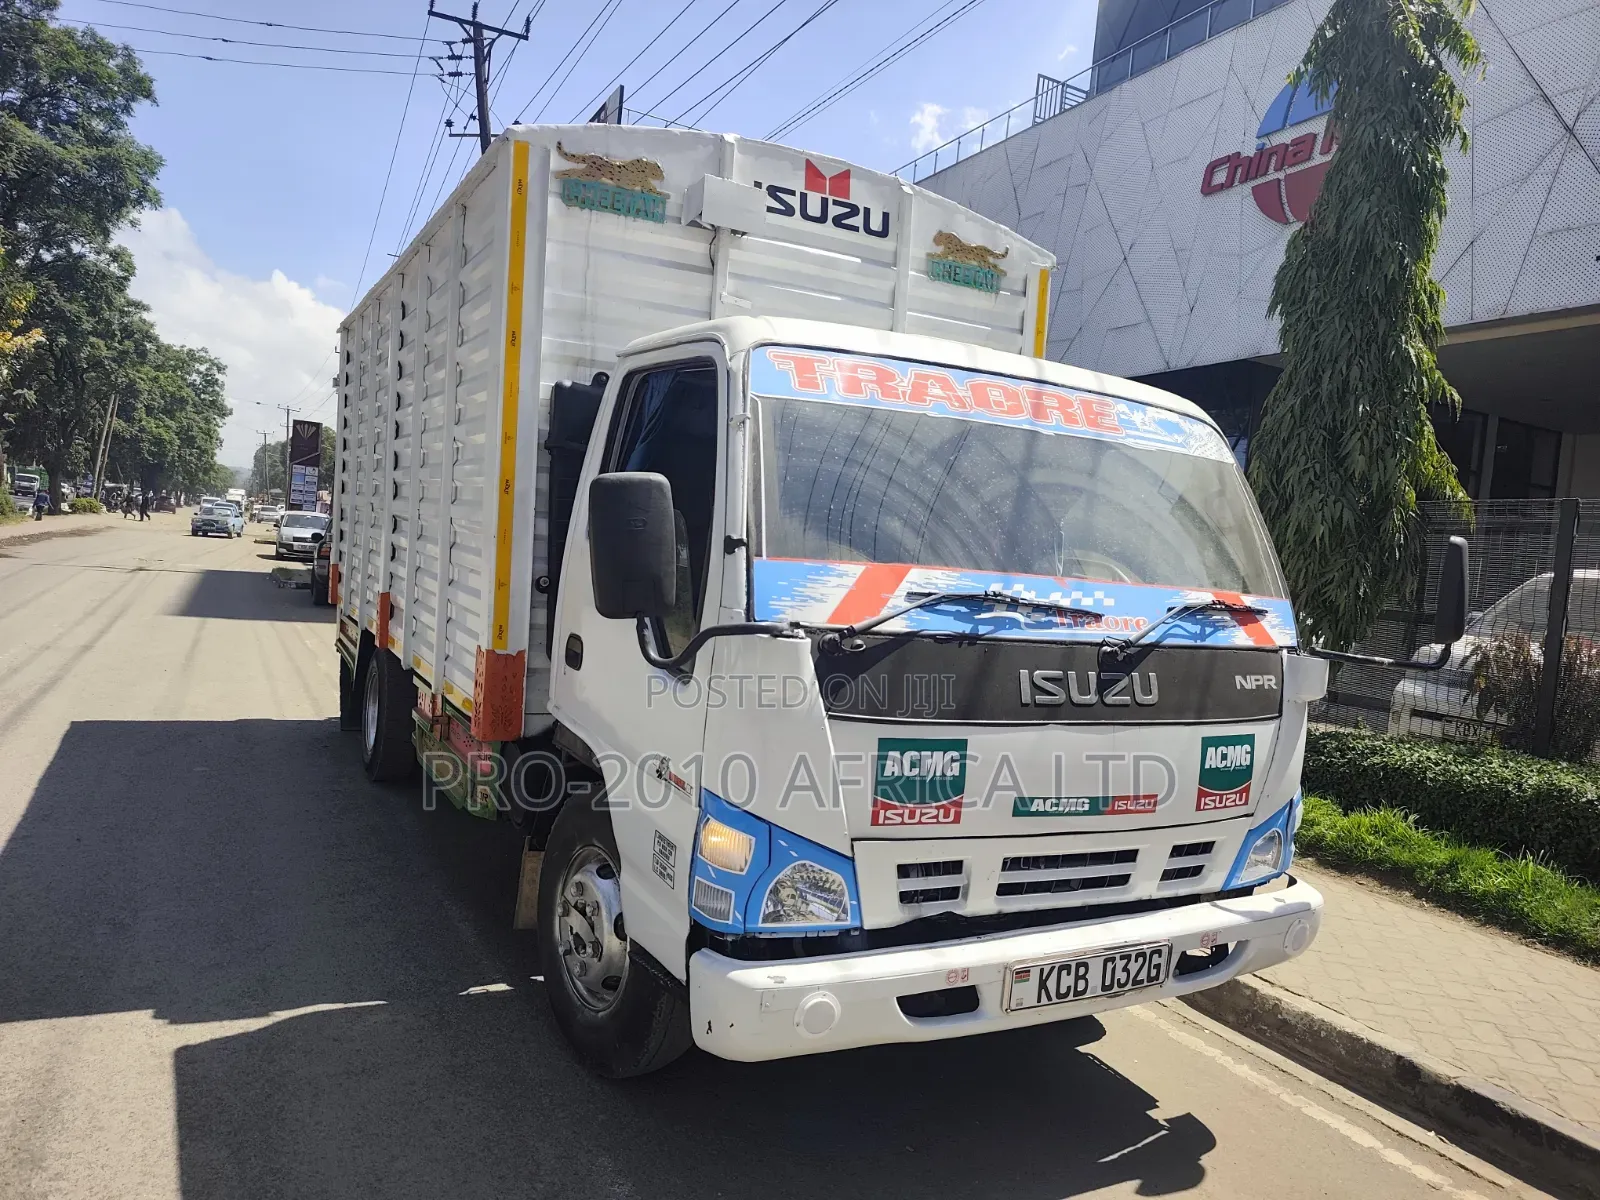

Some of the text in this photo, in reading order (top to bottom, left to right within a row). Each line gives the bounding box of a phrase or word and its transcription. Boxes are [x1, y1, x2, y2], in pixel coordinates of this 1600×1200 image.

[1200, 131, 1318, 197] China
[753, 180, 890, 239] SUZU
[766, 348, 1126, 436] TRAORE
[1050, 608, 1150, 632] Traore
[1019, 669, 1160, 706] ISUZU
[1235, 675, 1278, 690] NPR
[883, 750, 961, 783] ACMG
[1204, 744, 1252, 772] ACMG
[878, 808, 955, 824] ISUZU
[1029, 798, 1155, 814] ACMG ISUZU
[1200, 793, 1247, 810] ISUZU
[1036, 949, 1163, 1004] KCB 032G
